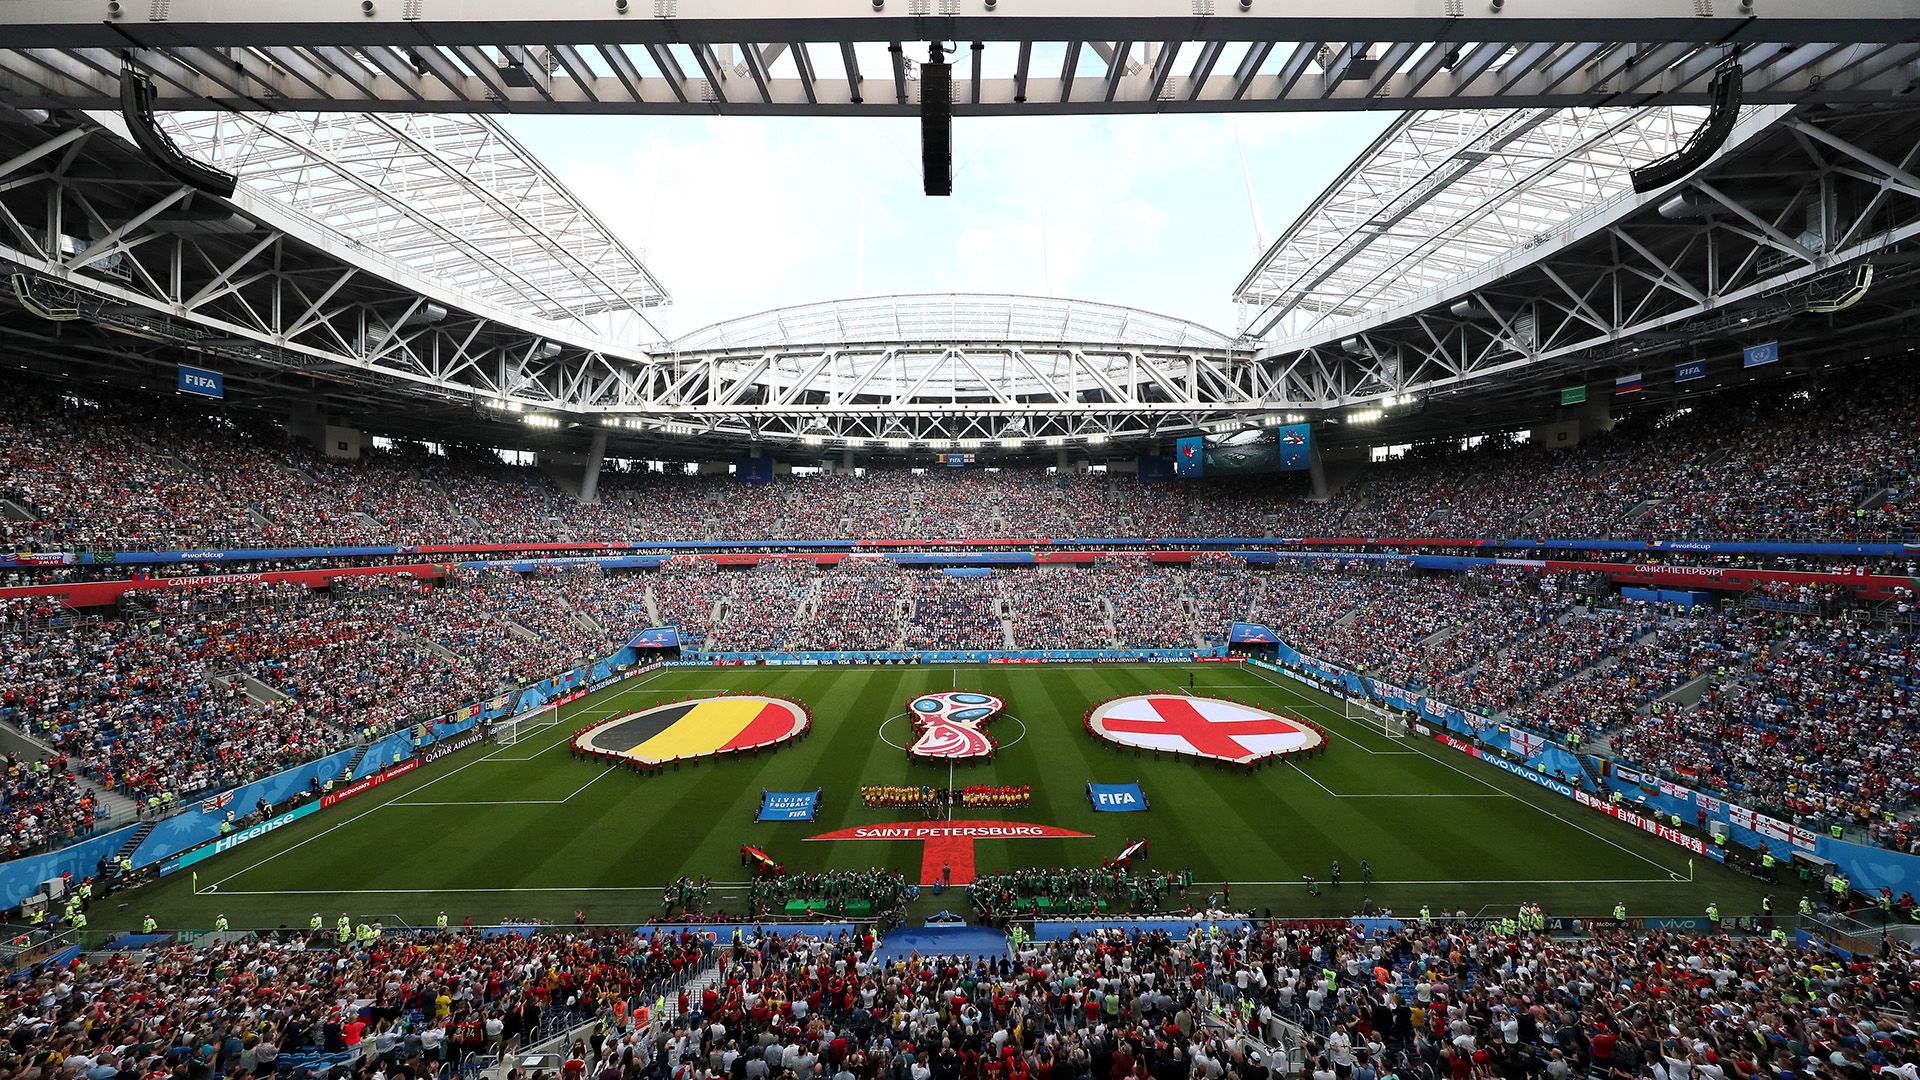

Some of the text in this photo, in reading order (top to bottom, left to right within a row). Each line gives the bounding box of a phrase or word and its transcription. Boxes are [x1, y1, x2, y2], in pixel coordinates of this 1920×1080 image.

[1679, 366, 1701, 377] FIFA
[185, 374, 217, 389] FIFA
[1635, 564, 1727, 577] САНКТ-ПЕТЕРБУРГ
[168, 573, 262, 587] САНКТ-ПЕТЕРБУРГ
[425, 733, 483, 763] QATAR AIRWAYS
[1446, 736, 1468, 753] Bud
[339, 762, 414, 798] McDonald's McDonald's
[1482, 753, 1571, 796] vivo vivo vivo
[1098, 792, 1136, 805] FIFA
[788, 810, 807, 818] FIFA
[215, 813, 295, 854] Hisense
[855, 826, 1043, 837] SAINT PETERSBURG
[1795, 828, 1815, 840] Y25
[1658, 825, 1702, 854] 天生要强
[1659, 918, 1696, 929] vivo
